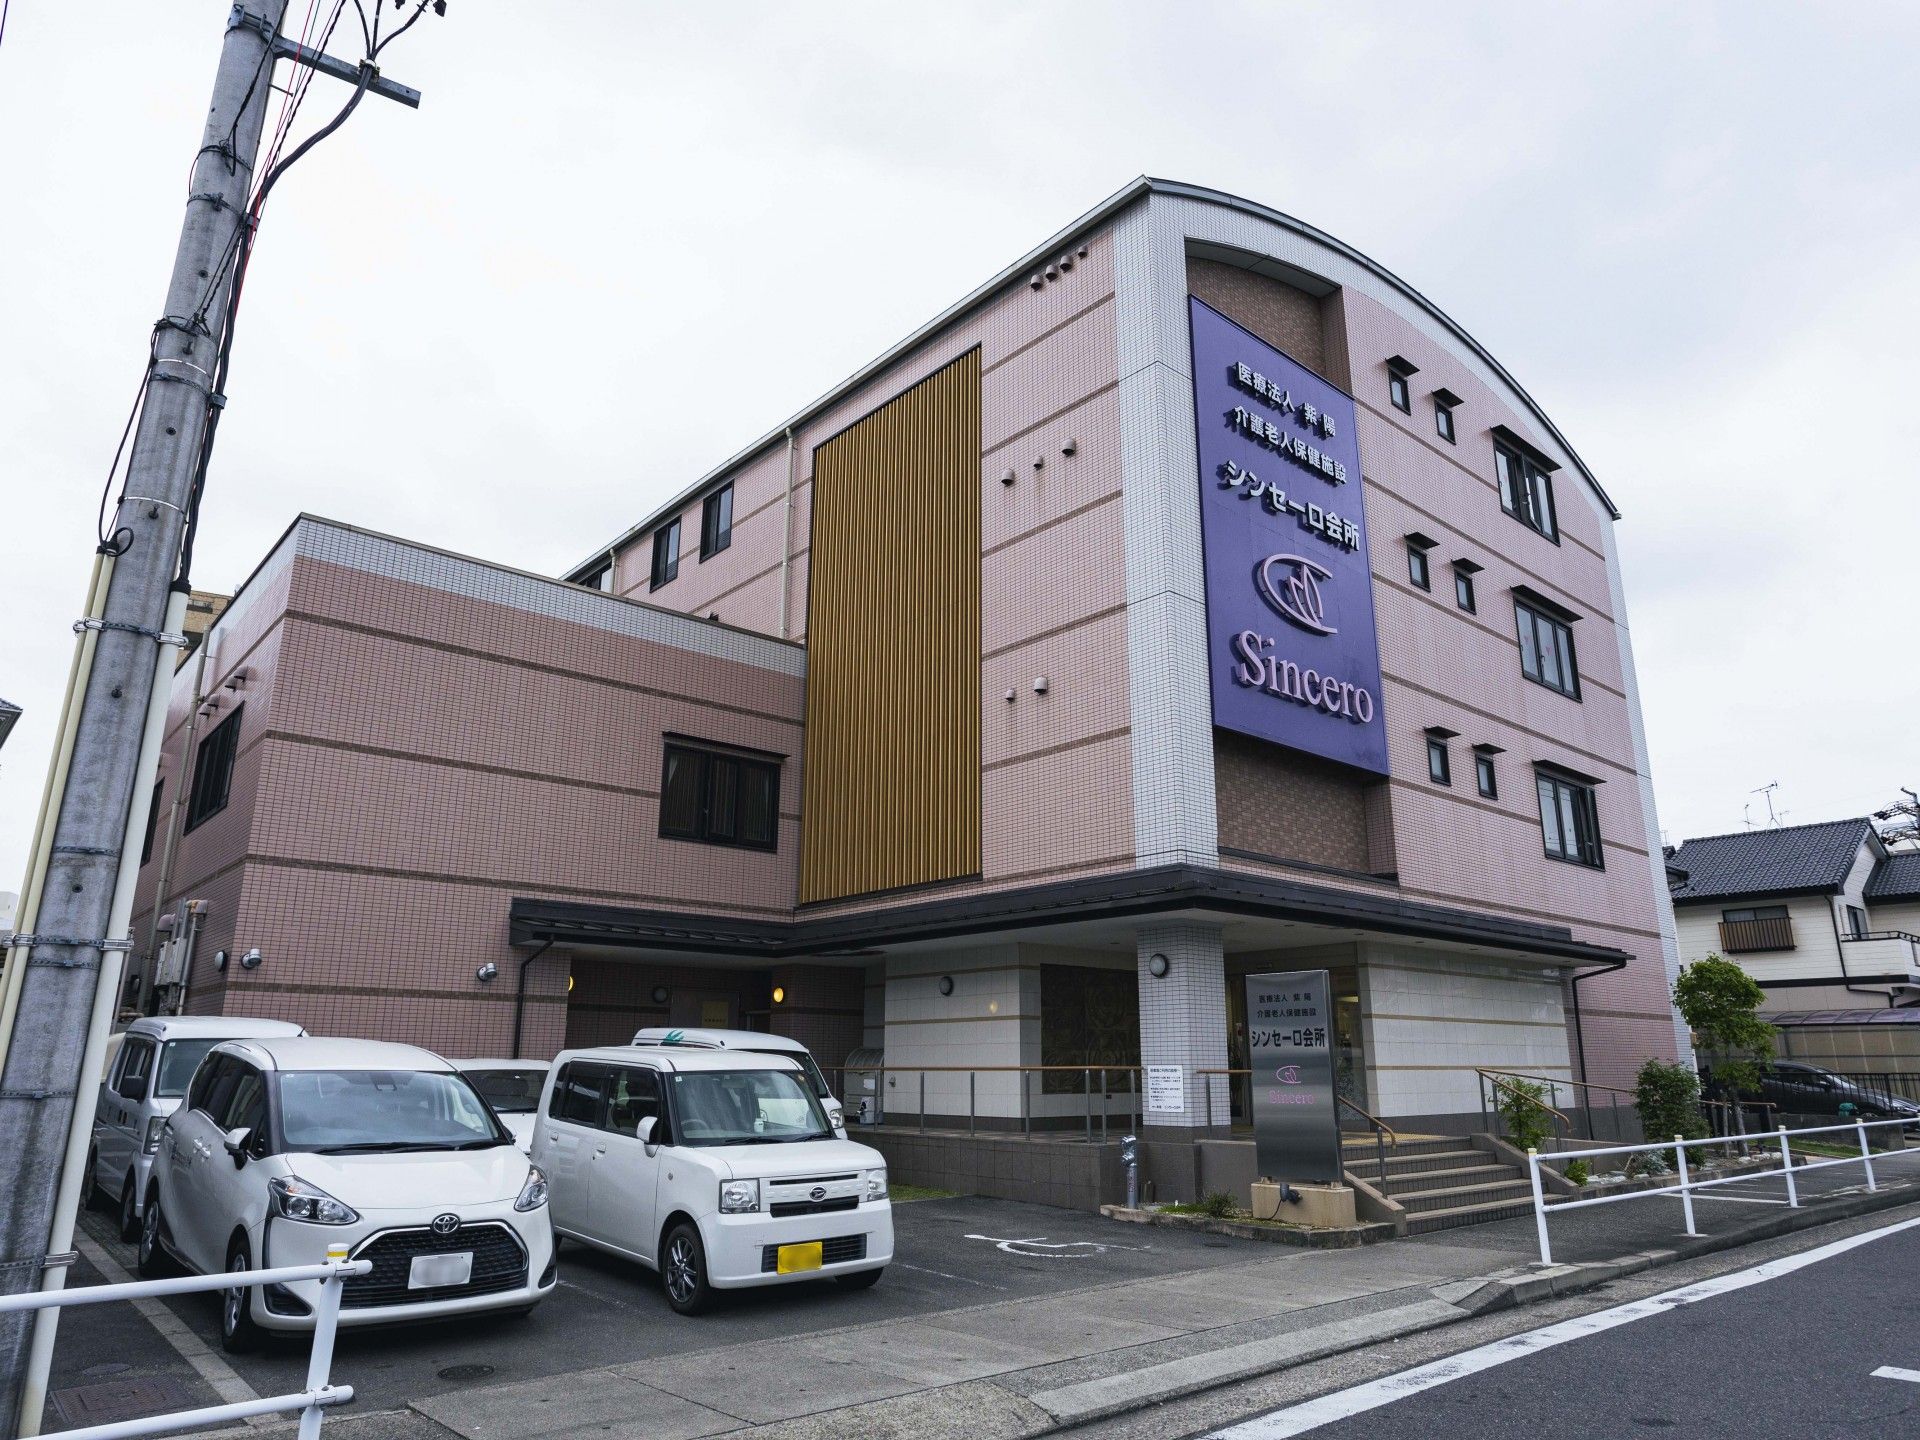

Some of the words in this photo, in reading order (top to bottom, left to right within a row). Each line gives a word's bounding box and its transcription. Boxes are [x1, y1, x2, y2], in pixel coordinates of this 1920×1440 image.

[1237, 361, 1295, 412] 医療法人
[1234, 405, 1347, 484] 介護老人保健施設
[1226, 459, 1360, 551] シンセーロ会所
[1236, 630, 1373, 723] Sincero
[1251, 1027, 1326, 1048] シンセーロ会所
[1257, 1007, 1317, 1018] 介護老人保健施設
[1269, 1089, 1315, 1104] Sincero
